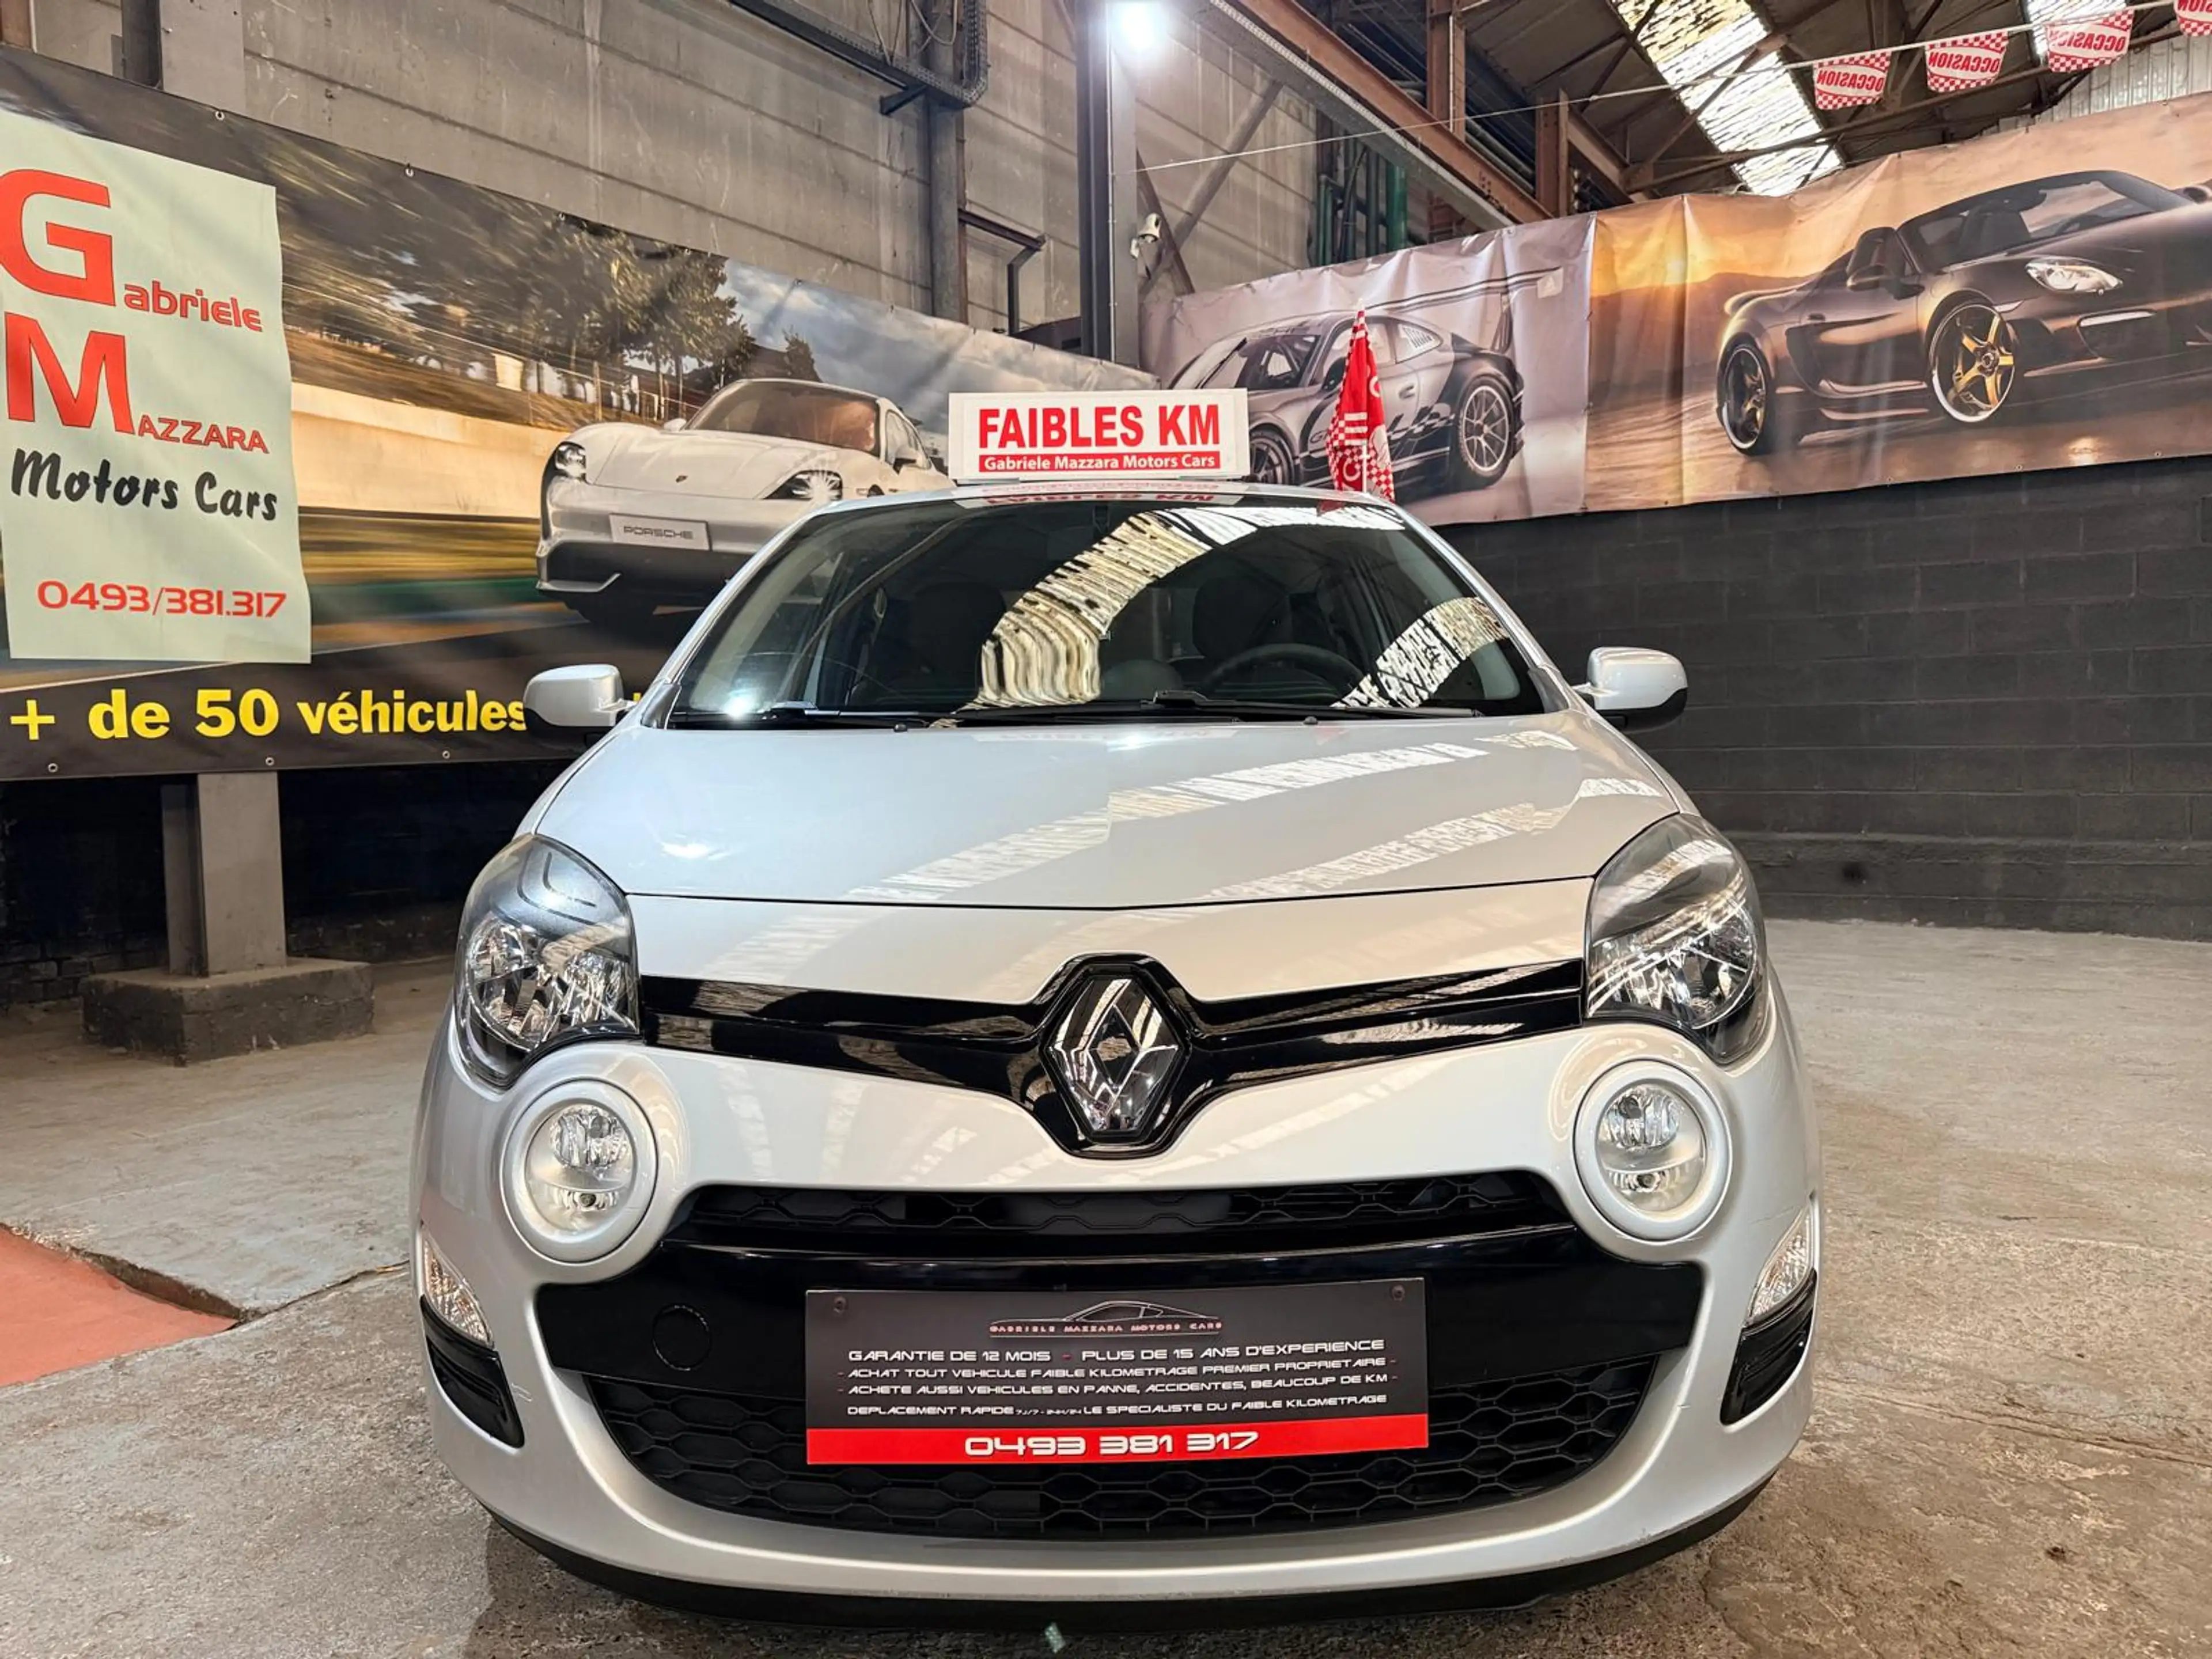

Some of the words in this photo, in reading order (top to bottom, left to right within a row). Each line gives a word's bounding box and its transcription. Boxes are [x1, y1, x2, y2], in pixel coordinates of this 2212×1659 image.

[979, 406, 1143, 449] FAIBLES
[1158, 404, 1219, 446] KM
[984, 456, 1050, 470] Gabriele
[1054, 456, 1119, 469] Mazzara
[1123, 454, 1177, 468] Motors
[1181, 454, 1215, 467] Cars
[11, 448, 178, 510] Motors
[195, 471, 277, 521] Cars
[38, 581, 286, 618] 0493/381.317
[88, 689, 170, 738] de
[195, 689, 279, 736] 50
[297, 689, 527, 735] véhicules
[849, 1351, 944, 1361] GARANTIE
[950, 1351, 976, 1361] DE
[982, 1351, 999, 1361] 12
[1005, 1351, 1051, 1361] MOIS
[1082, 1350, 1135, 1361] PLUS
[1141, 1349, 1167, 1359] DE
[1173, 1349, 1194, 1358] 15
[1200, 1347, 1240, 1358] ANS
[1245, 1339, 1384, 1356] D'EXPERIENCE
[849, 1369, 900, 1377] ACHAT
[905, 1369, 948, 1377] TOUT
[952, 1369, 1027, 1378] VEHICULE
[1031, 1369, 1085, 1378] FAIBLE
[1089, 1366, 1197, 1377] KILOMETRAGE
[1202, 1363, 1270, 1374] PREMIER
[1274, 1357, 1385, 1371] PROPRIETAIRE
[849, 1385, 911, 1394] ACHETE
[916, 1385, 963, 1394] AUSSI
[967, 1385, 1053, 1394] VEHICULES
[1058, 1385, 1080, 1393] EN
[1084, 1384, 1140, 1394] PANNE,
[1251, 1377, 1336, 1388] BEAUCOUP
[1340, 1375, 1361, 1384] DE
[1365, 1374, 1388, 1383] KM
[847, 1406, 957, 1415] DEPLACEMENT
[961, 1406, 1014, 1414] RAPIDE
[1084, 1406, 1102, 1414] LE
[1106, 1403, 1202, 1414] SPECIALISTE
[1207, 1403, 1228, 1411] DU
[1232, 1400, 1282, 1410] FAIBLE
[1286, 1395, 1387, 1407] KILOMETRAGE
[965, 1437, 1086, 1455] 0493
[1100, 1435, 1172, 1454] 381
[1187, 1431, 1258, 1451] 317
